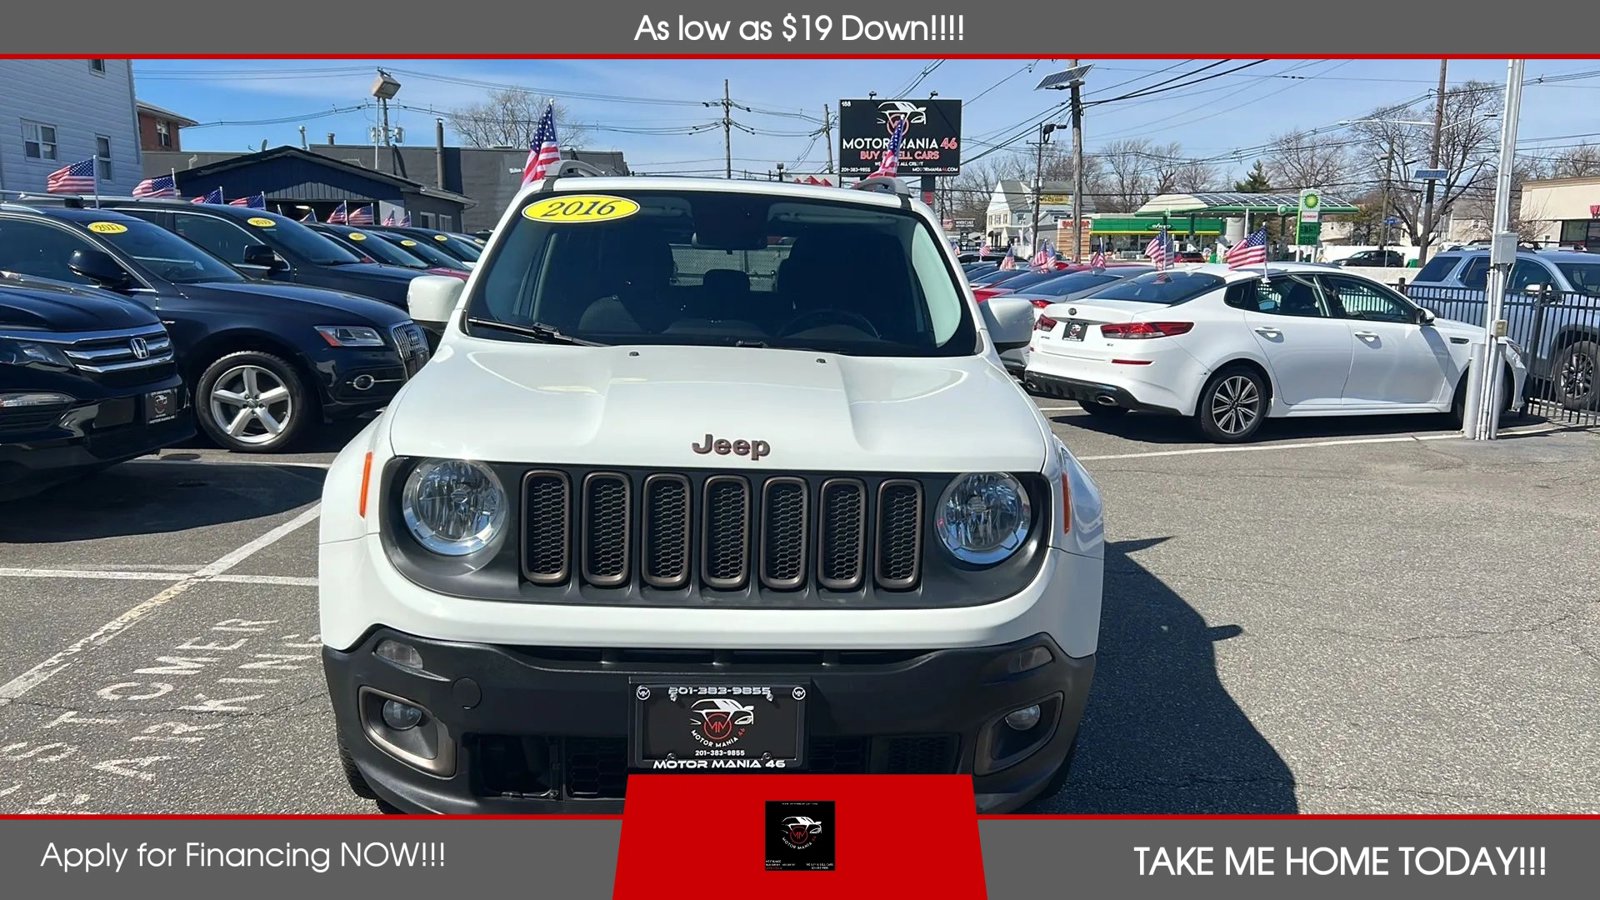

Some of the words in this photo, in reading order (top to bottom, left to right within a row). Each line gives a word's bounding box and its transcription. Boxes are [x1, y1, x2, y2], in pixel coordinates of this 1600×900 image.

[843, 138, 890, 149] MOTOR
[940, 137, 958, 149] 46
[860, 151, 879, 159] BUY
[898, 151, 912, 159] ELL
[914, 151, 939, 159] CARS
[546, 198, 625, 219] 2016
[691, 433, 771, 461] Jeep
[668, 686, 772, 696] 201-383-9855
[690, 729, 715, 748] MOTOR
[715, 736, 739, 748] MANIA
[695, 749, 746, 757] 201-383-9855
[653, 759, 708, 769] MOTOR
[711, 759, 762, 769] MANIA
[765, 759, 786, 769] 46
